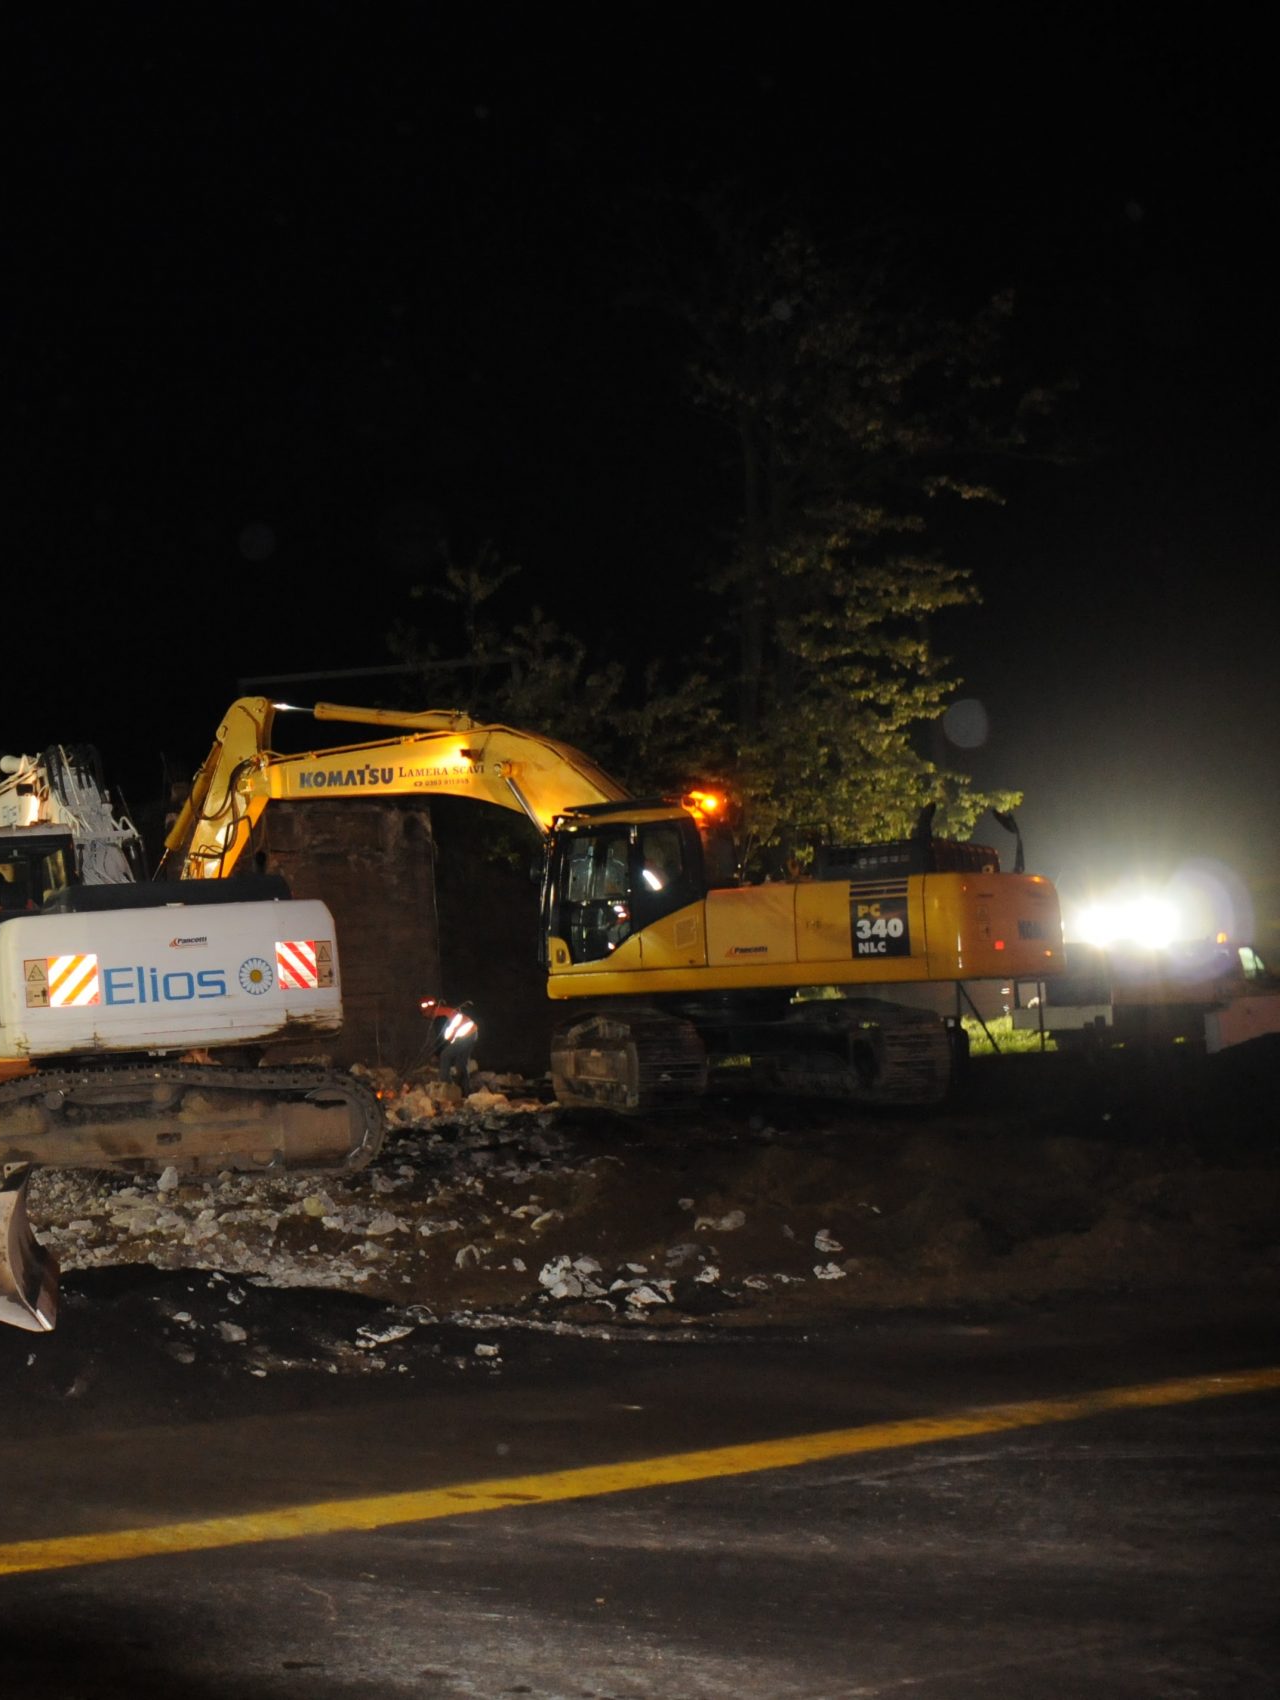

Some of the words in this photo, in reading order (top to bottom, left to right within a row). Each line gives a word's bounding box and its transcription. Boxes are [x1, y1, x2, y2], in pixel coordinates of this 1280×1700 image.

[299, 763, 394, 789] KOMATSU
[399, 766, 449, 778] LAMERA
[857, 903, 881, 918] PC
[856, 917, 904, 940] 340
[858, 941, 887, 954] NLC
[103, 966, 227, 1006] Elios
